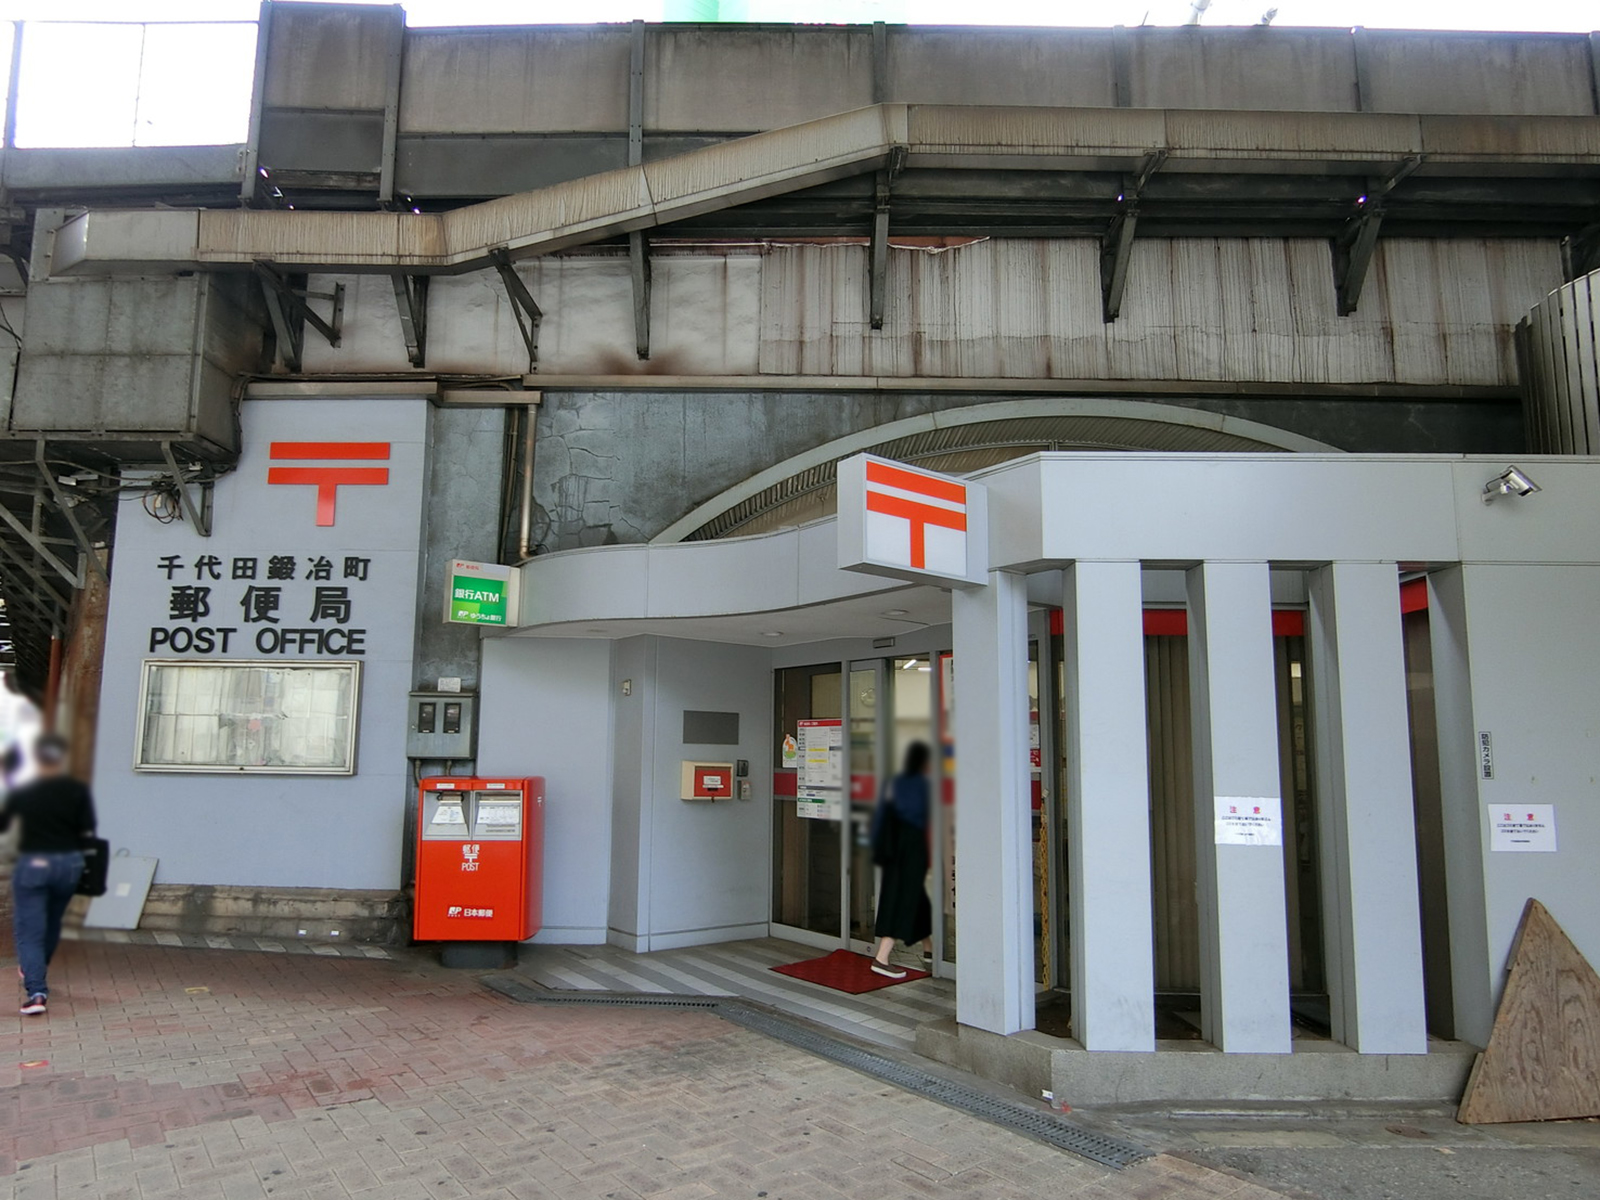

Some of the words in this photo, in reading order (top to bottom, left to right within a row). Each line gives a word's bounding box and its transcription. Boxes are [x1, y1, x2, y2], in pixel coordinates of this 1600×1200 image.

[157, 555, 371, 581] 千代田鍛冶町
[169, 585, 351, 624] 郵便局
[455, 588, 499, 602] 銀行ATM
[149, 627, 237, 653] POST
[255, 627, 366, 655] OFFICE
[461, 863, 480, 872] POST
[464, 908, 493, 918] 日本郵便
